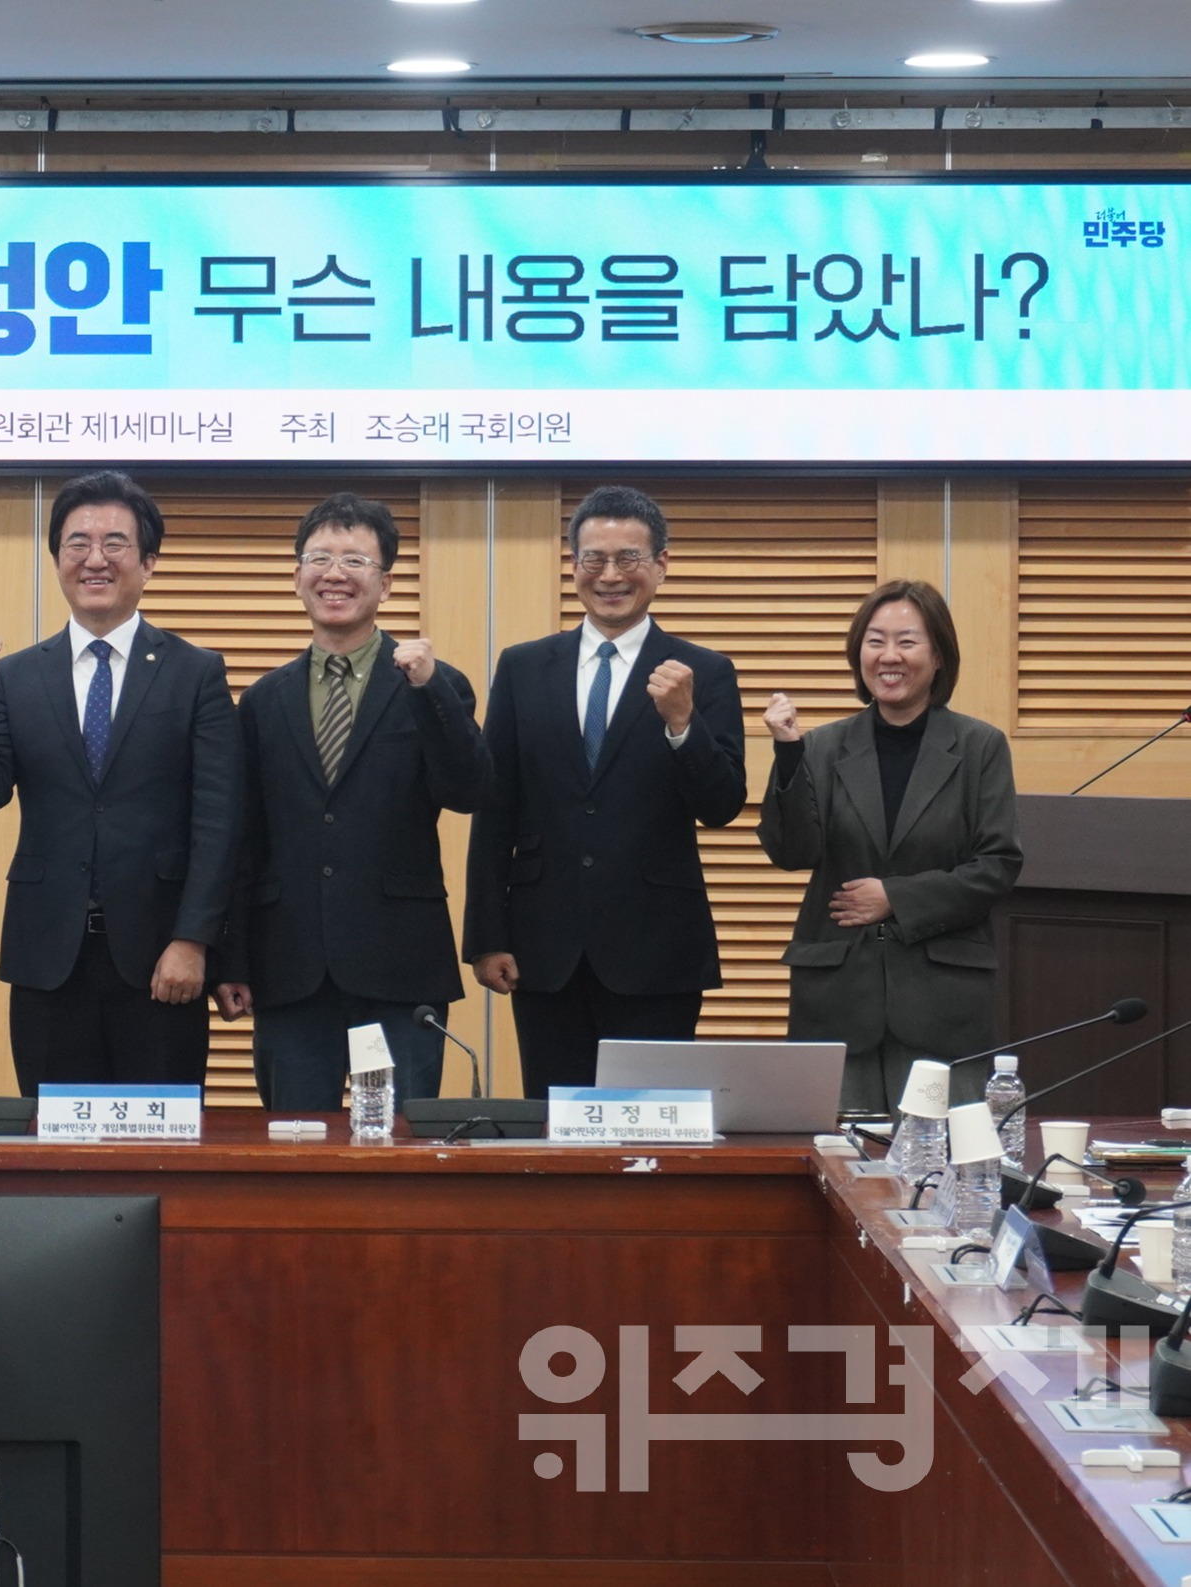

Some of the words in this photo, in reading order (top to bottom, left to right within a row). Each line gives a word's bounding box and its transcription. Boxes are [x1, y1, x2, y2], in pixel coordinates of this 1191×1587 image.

[1083, 221, 1166, 248] 민주당
[194, 254, 376, 344] 무슨
[411, 254, 684, 343] 내용을
[720, 252, 1050, 344] 담았나?
[81, 411, 234, 444] 제1세미나실
[280, 411, 335, 444] 주최
[365, 411, 450, 444] 조승래
[459, 411, 571, 444] 국회의원
[42, 1123, 97, 1134] 더불어민주당
[169, 1124, 197, 1135] 위원장
